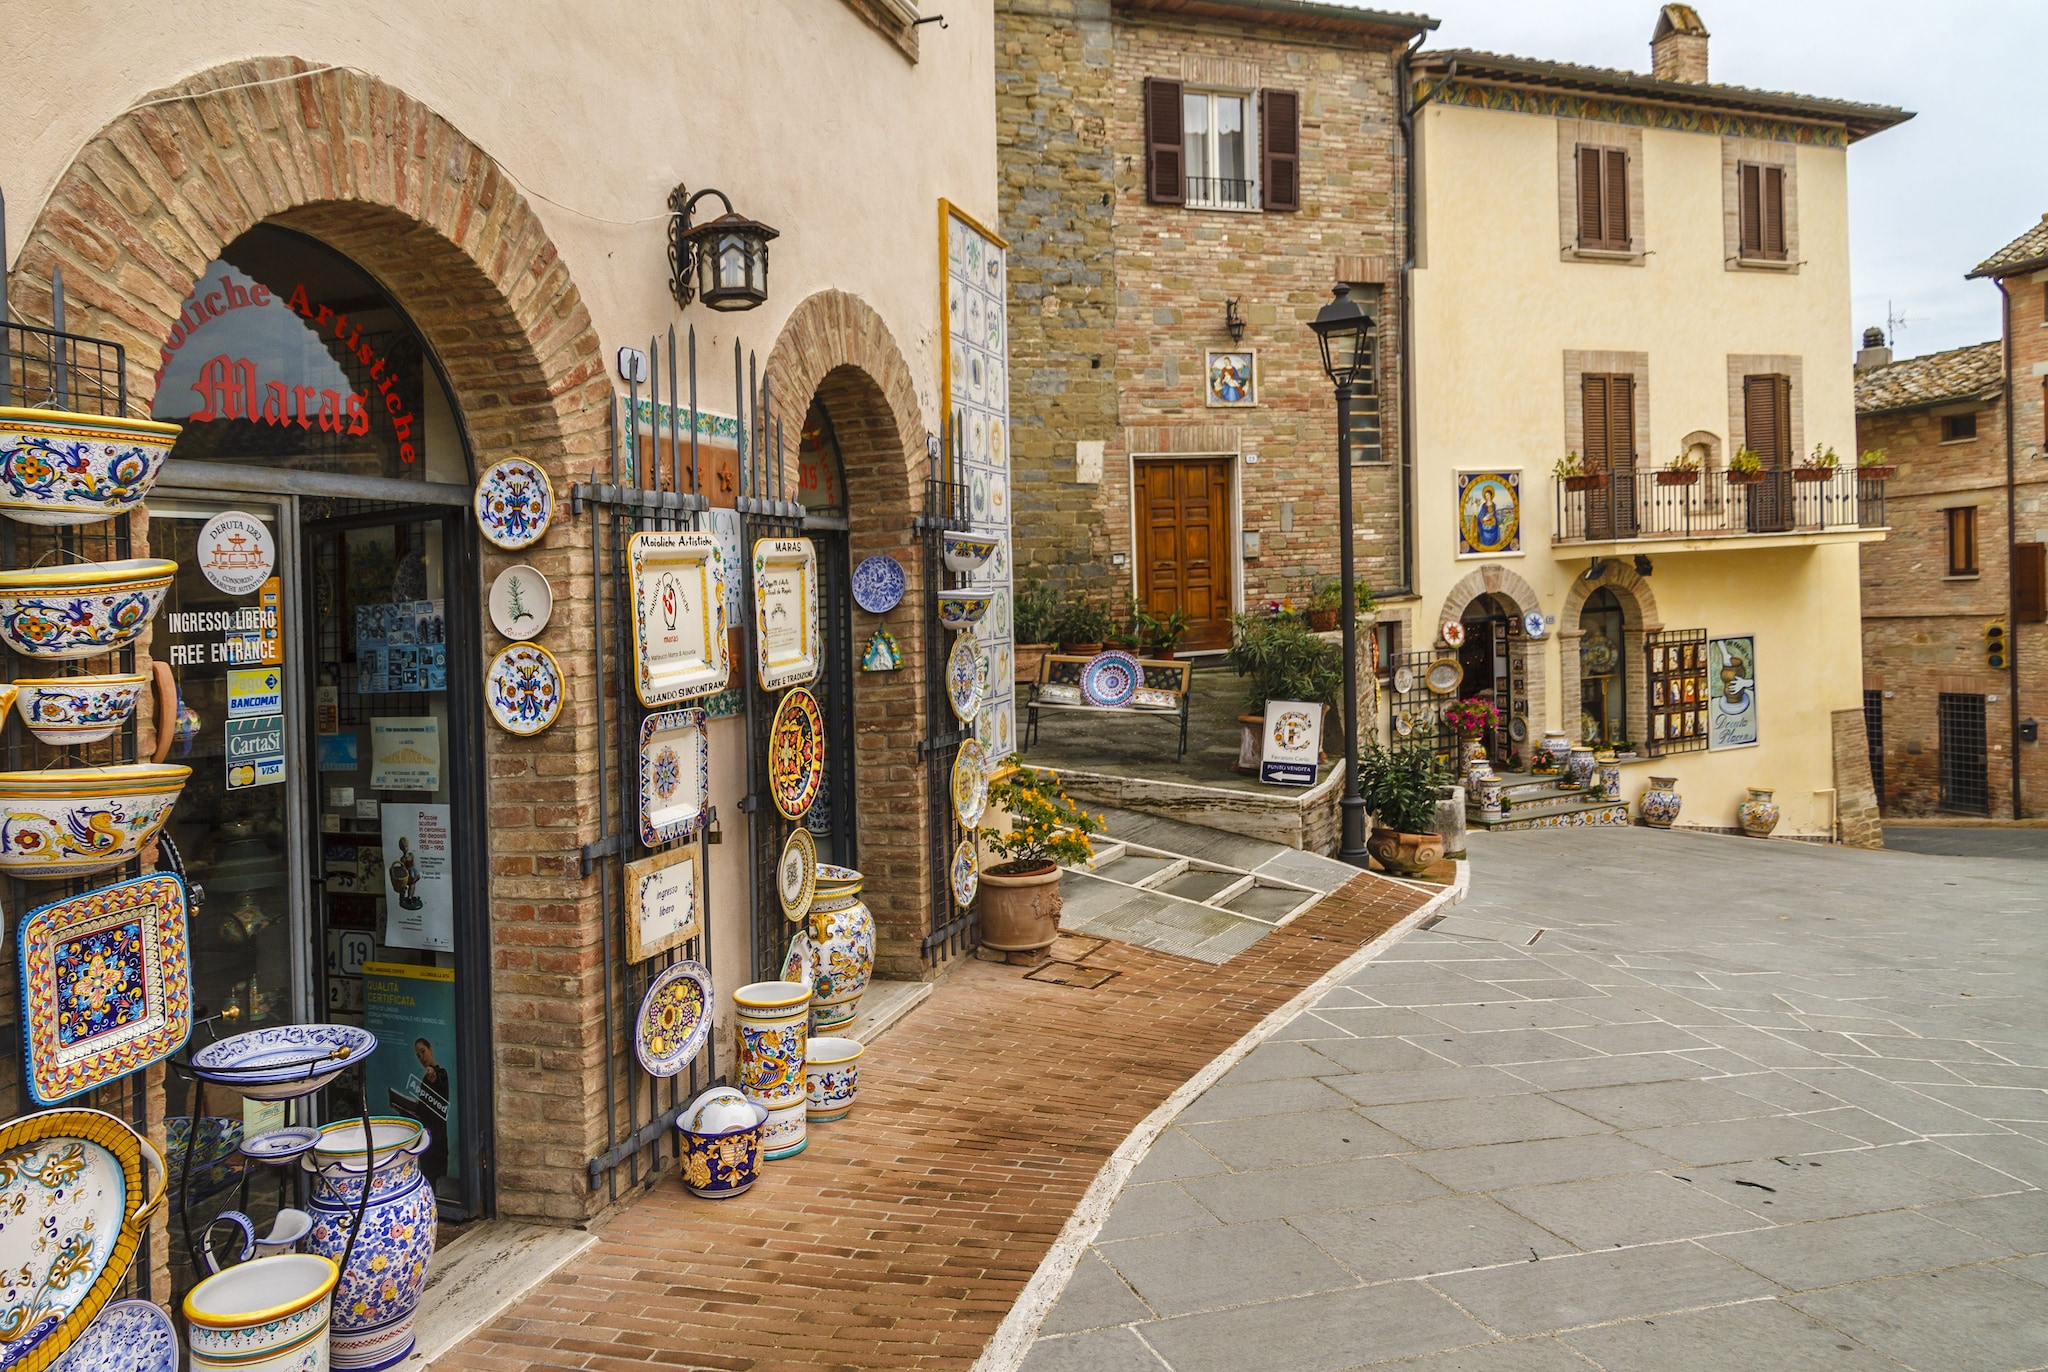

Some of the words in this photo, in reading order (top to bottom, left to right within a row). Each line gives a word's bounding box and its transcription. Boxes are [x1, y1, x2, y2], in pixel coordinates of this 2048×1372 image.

[284, 283, 416, 463] Artistiche
[189, 352, 369, 437] Maras
[210, 520, 244, 540] DERUTA
[246, 524, 262, 542] 1282
[640, 536, 676, 548] Maioliche
[678, 535, 712, 546] Artistiche
[775, 542, 802, 552] MARAS
[207, 571, 236, 592] CERAMICHE
[222, 575, 254, 584] CONSORZIO
[168, 612, 230, 633] INGRESSO
[236, 610, 274, 630] LIBERO
[170, 644, 204, 666] FREE
[212, 640, 276, 663] ENTRANCE
[230, 674, 262, 693] Pago
[766, 679, 781, 688] ARTE
[788, 670, 813, 682] TRADIZIONE
[231, 696, 278, 708] BANCOMAT
[645, 690, 677, 704] QUANDO
[262, 766, 279, 775] VISA
[419, 812, 438, 820] Piccole
[656, 885, 678, 900] ingresso
[659, 905, 674, 917] libero
[348, 941, 367, 966] 19
[368, 980, 399, 993] QUALITÀ
[368, 992, 415, 1007] CERTIFICATA
[410, 1080, 448, 1114] Approved
